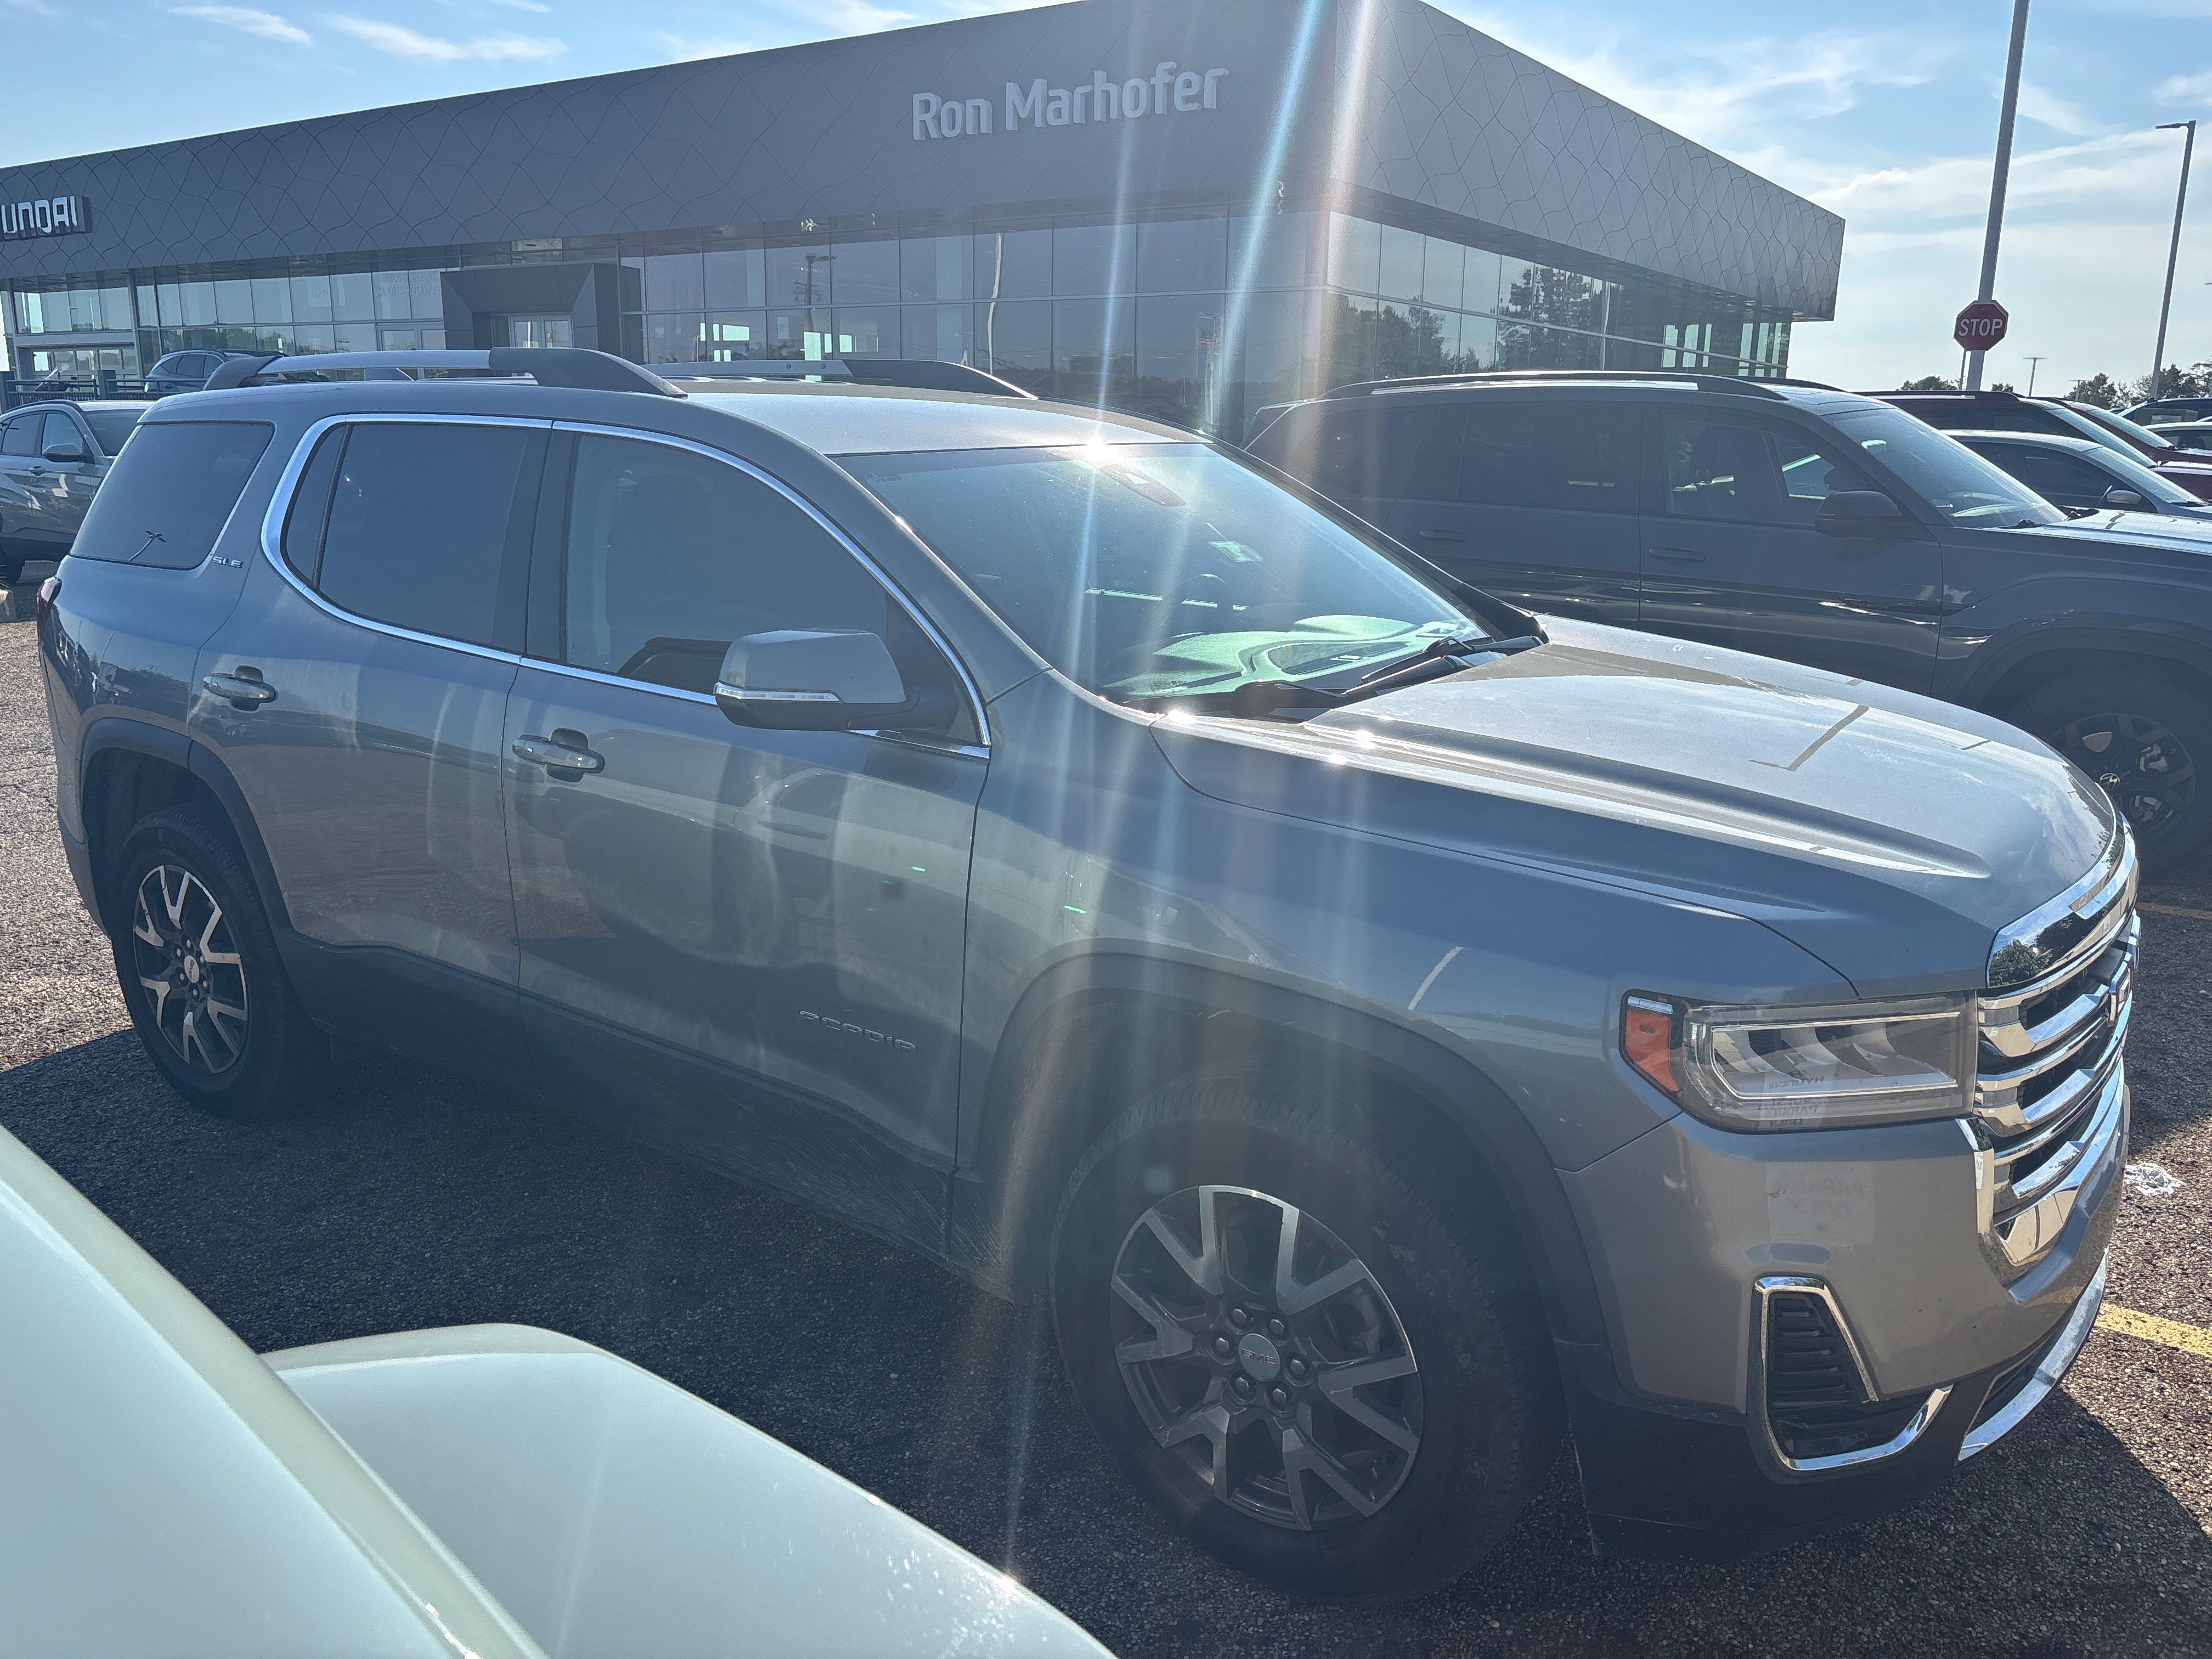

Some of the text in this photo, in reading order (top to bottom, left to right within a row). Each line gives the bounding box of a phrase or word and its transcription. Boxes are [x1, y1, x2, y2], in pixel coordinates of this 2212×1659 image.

[912, 61, 1229, 140] Ron Marhofer
[1958, 318, 2003, 336] STOP
[212, 556, 244, 568] SLE
[1242, 1348, 1277, 1366] GMC
